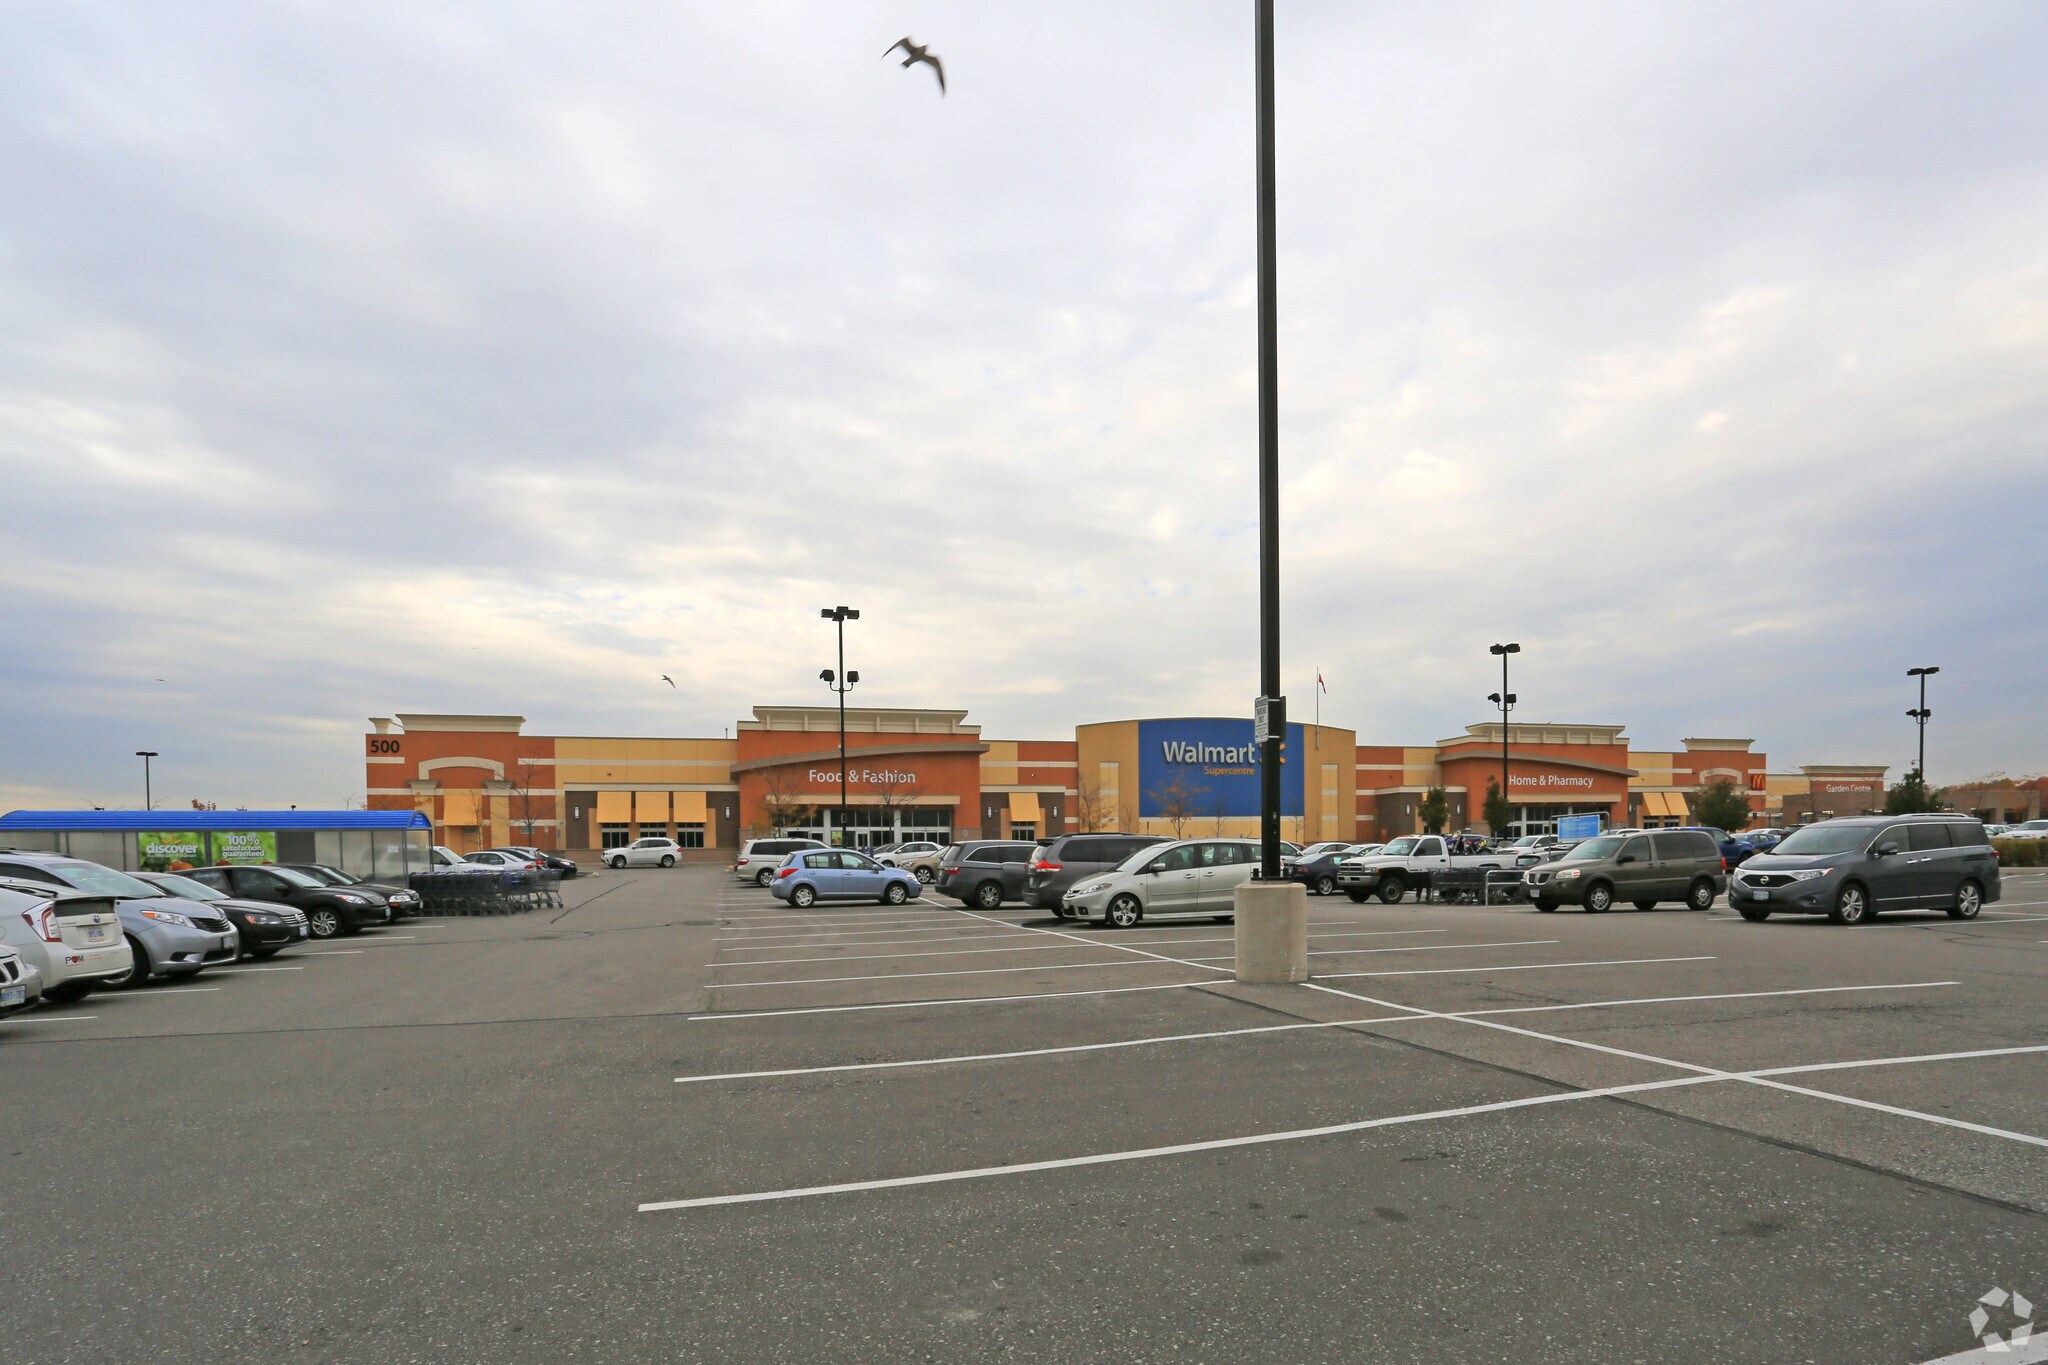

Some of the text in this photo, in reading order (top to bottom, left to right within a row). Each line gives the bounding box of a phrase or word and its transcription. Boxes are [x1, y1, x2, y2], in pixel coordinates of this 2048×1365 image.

[370, 740, 400, 753] 500
[1163, 741, 1255, 763] Walmart
[1204, 766, 1255, 775] Supercentre
[848, 769, 859, 783] &
[862, 769, 916, 783] Fashion
[1508, 774, 1594, 788] Home & Pharmacy
[1826, 784, 1871, 793] Garden Centre
[226, 835, 260, 845] 100%
[146, 843, 198, 853] discover
[222, 850, 265, 858] guaranteed
